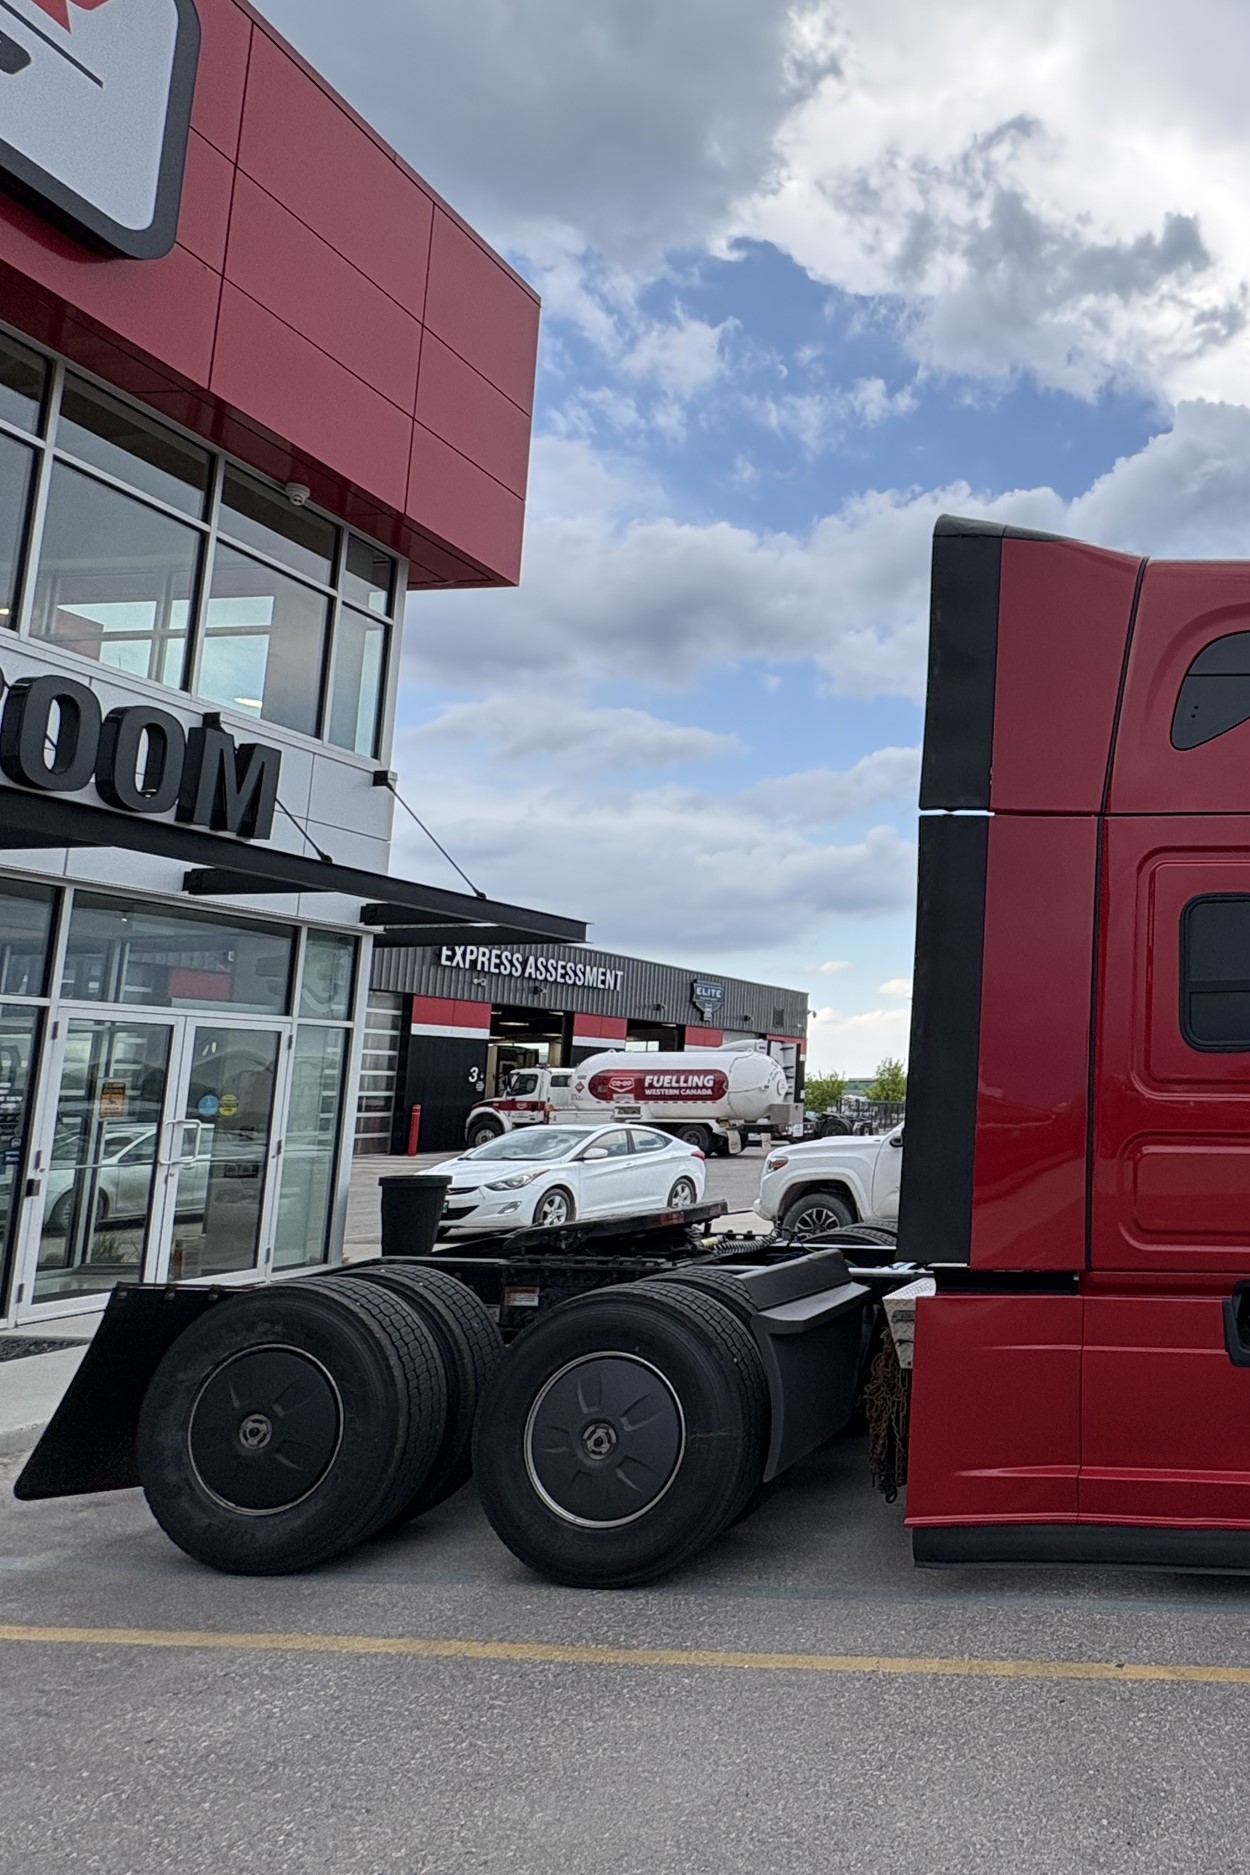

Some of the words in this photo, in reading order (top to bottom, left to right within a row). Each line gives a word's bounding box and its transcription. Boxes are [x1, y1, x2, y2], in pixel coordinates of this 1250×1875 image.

[0, 667, 282, 840] OOM
[440, 945, 523, 977] EXPRESS
[524, 955, 624, 991] ASSESSMENT
[696, 987, 722, 998] ELITE
[468, 1066, 479, 1083] 3
[644, 1075, 715, 1087] FUELLING
[645, 1088, 680, 1096] WESTERN
